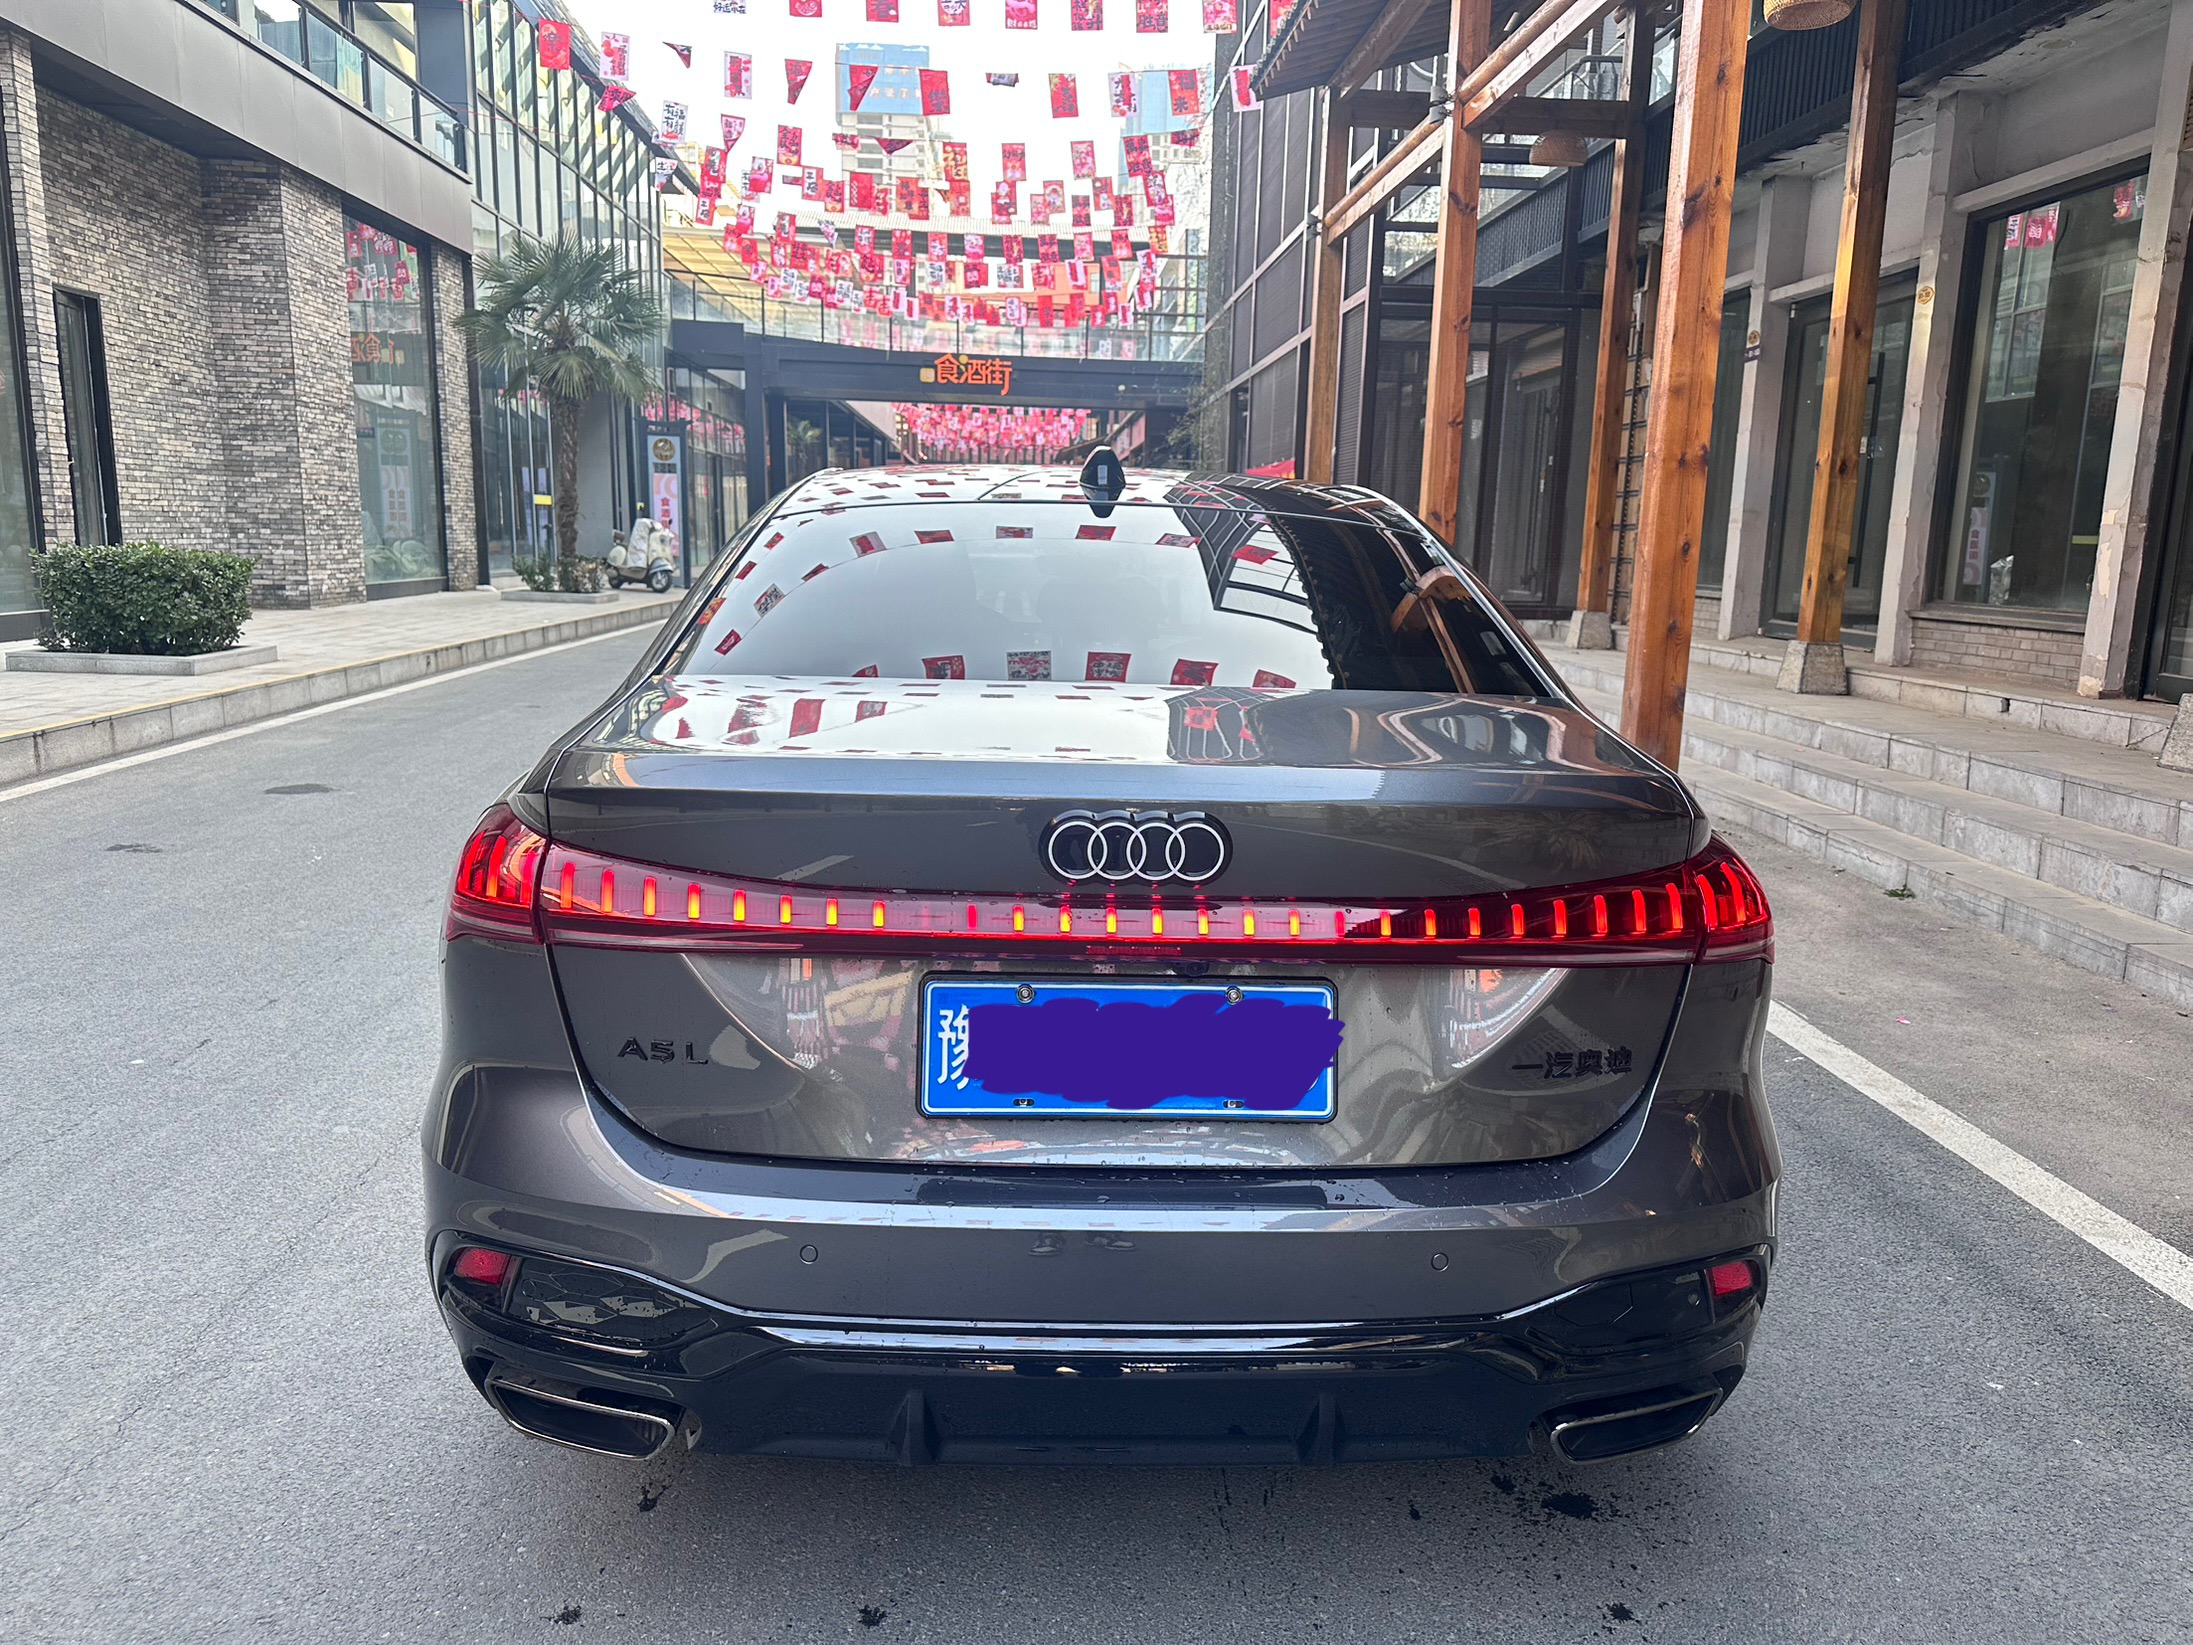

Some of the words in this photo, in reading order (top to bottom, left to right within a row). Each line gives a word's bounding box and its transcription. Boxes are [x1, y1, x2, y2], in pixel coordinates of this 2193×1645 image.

[934, 353, 1013, 396] 食酒街
[1511, 1046, 1633, 1079] 一汽奥迪
